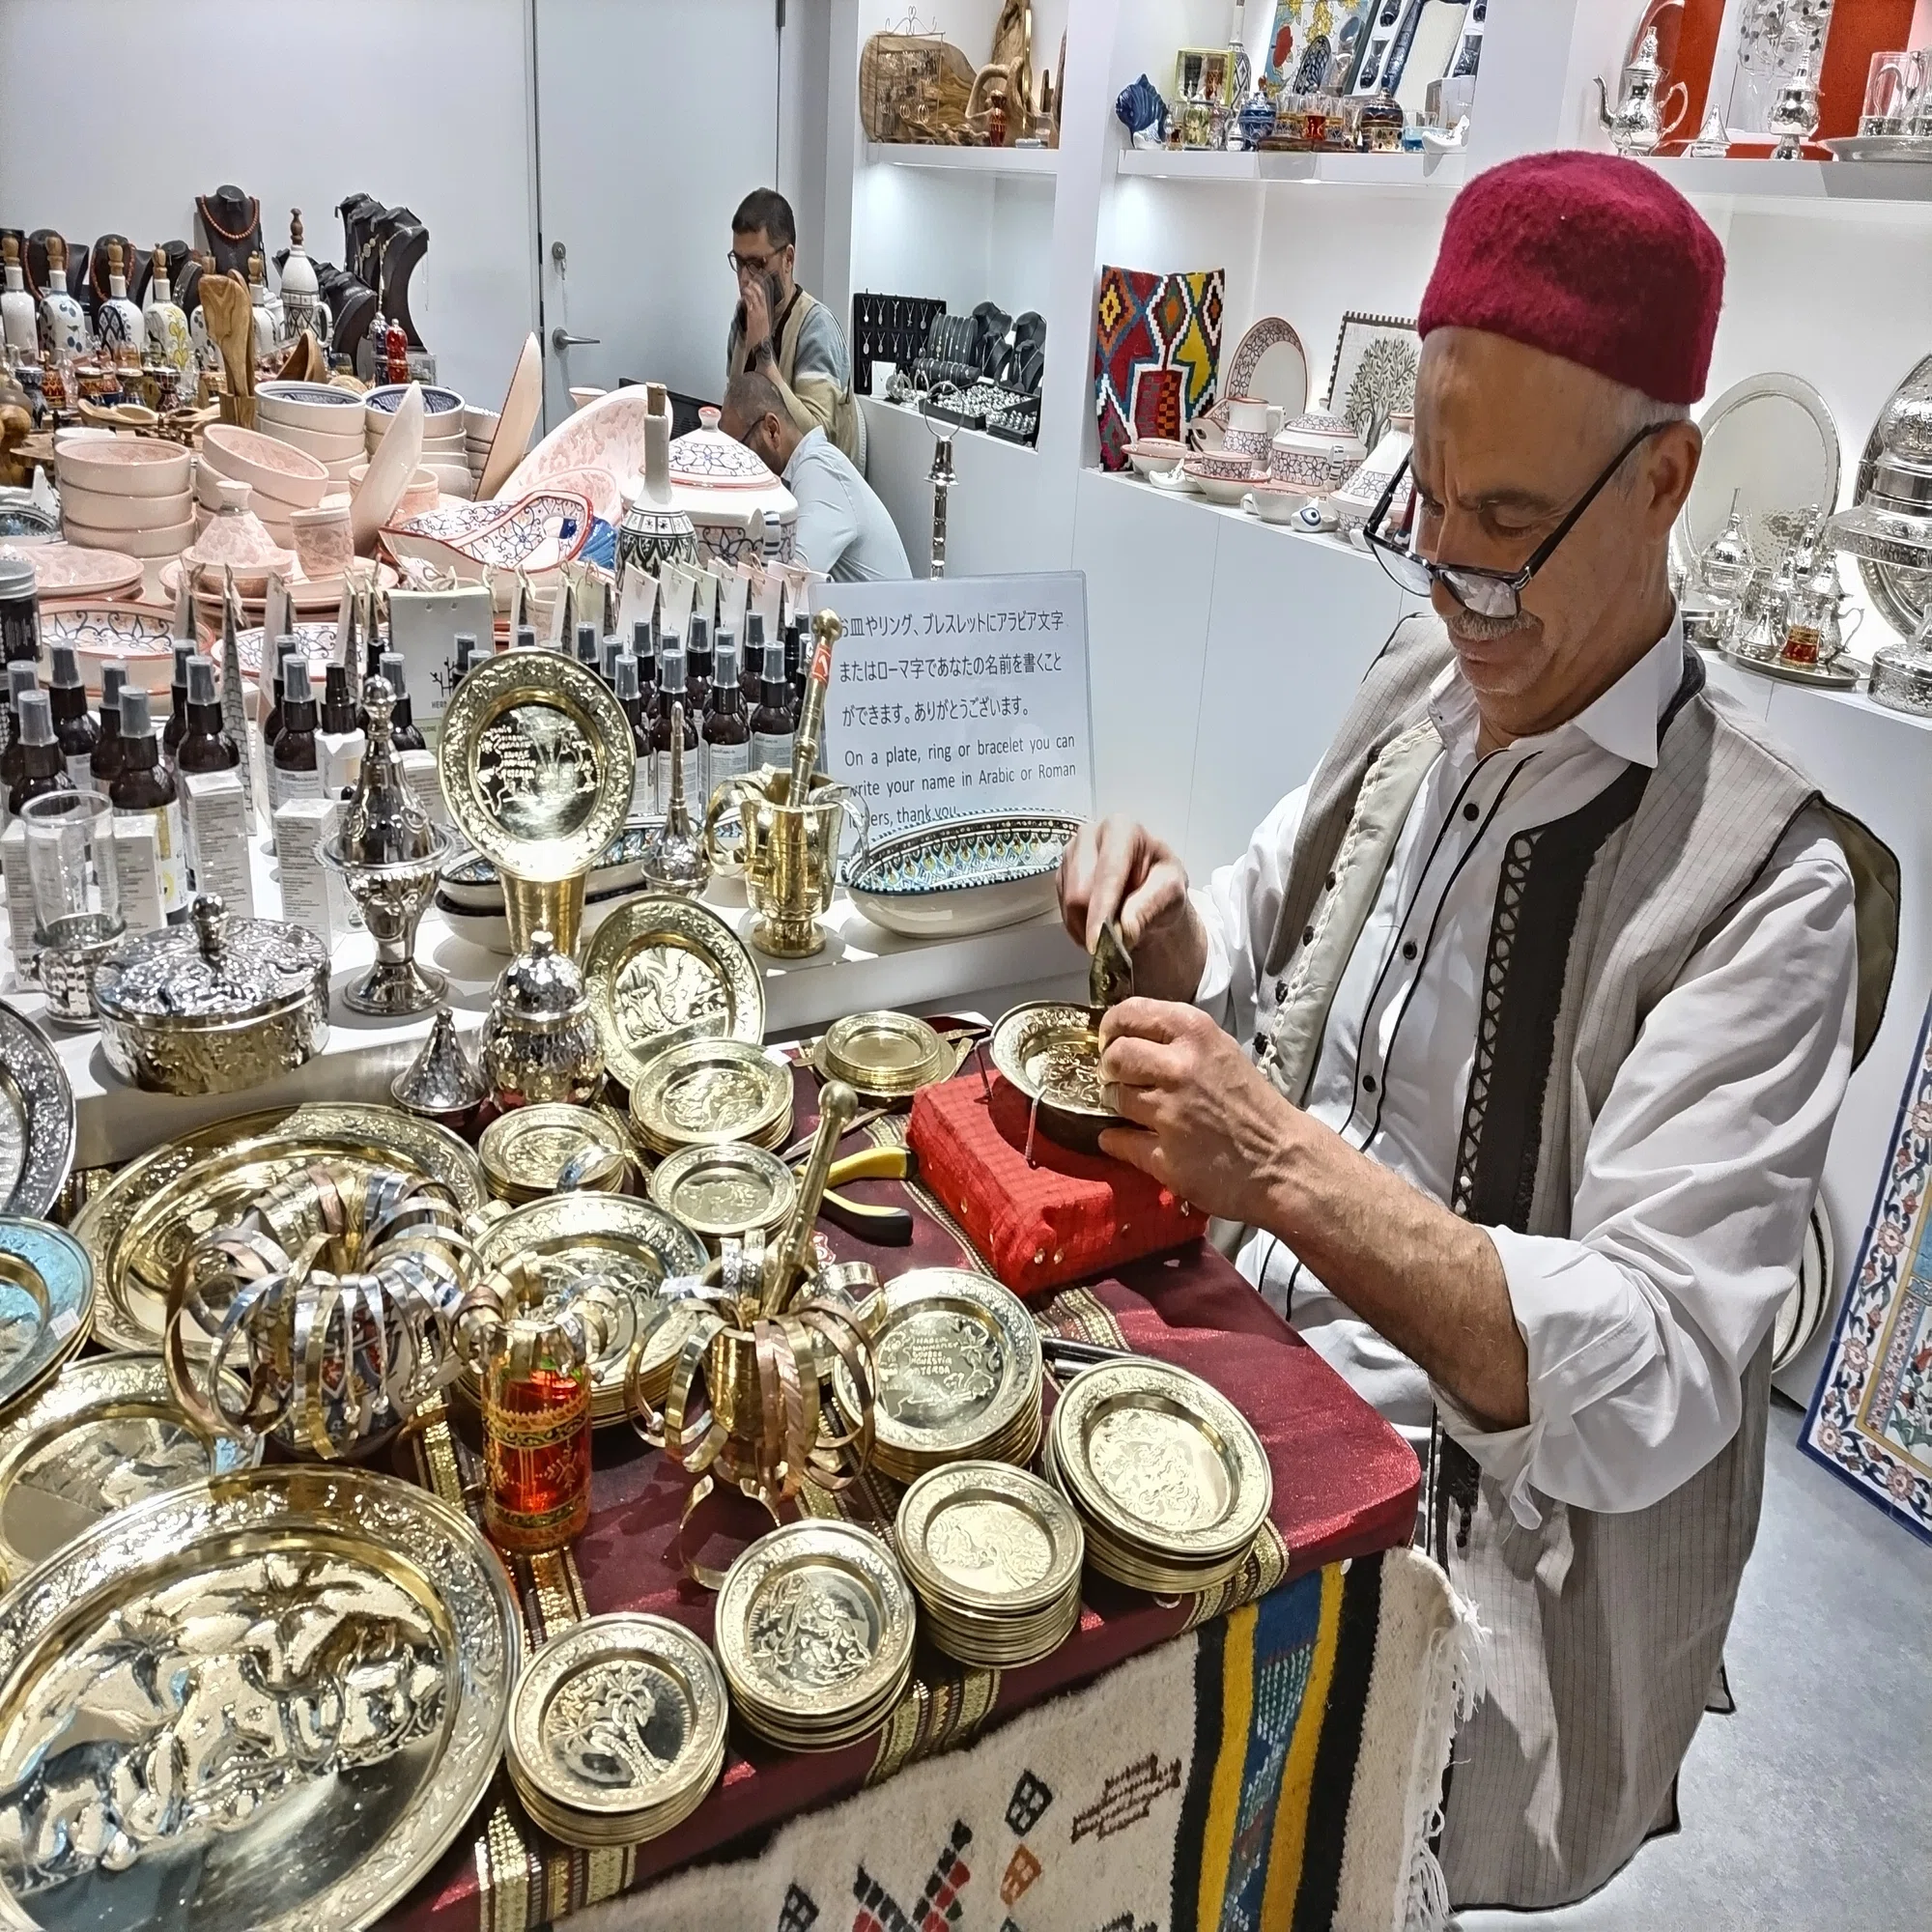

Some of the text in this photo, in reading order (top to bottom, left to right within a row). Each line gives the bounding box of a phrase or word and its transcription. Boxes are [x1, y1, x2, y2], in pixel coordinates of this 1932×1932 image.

[839, 652, 1063, 683] またはローマ字であなたの名前を書くこと
[842, 696, 1028, 726] ができます。ありがとうございます。
[844, 735, 1075, 767] On a plate, ring or bracelet you can
[886, 780, 915, 798] your
[922, 776, 955, 791] name
[961, 771, 973, 786] in
[979, 767, 1015, 785] Arabic
[1020, 768, 1033, 781] or
[1038, 764, 1076, 780] Roman
[896, 804, 931, 824] thank
